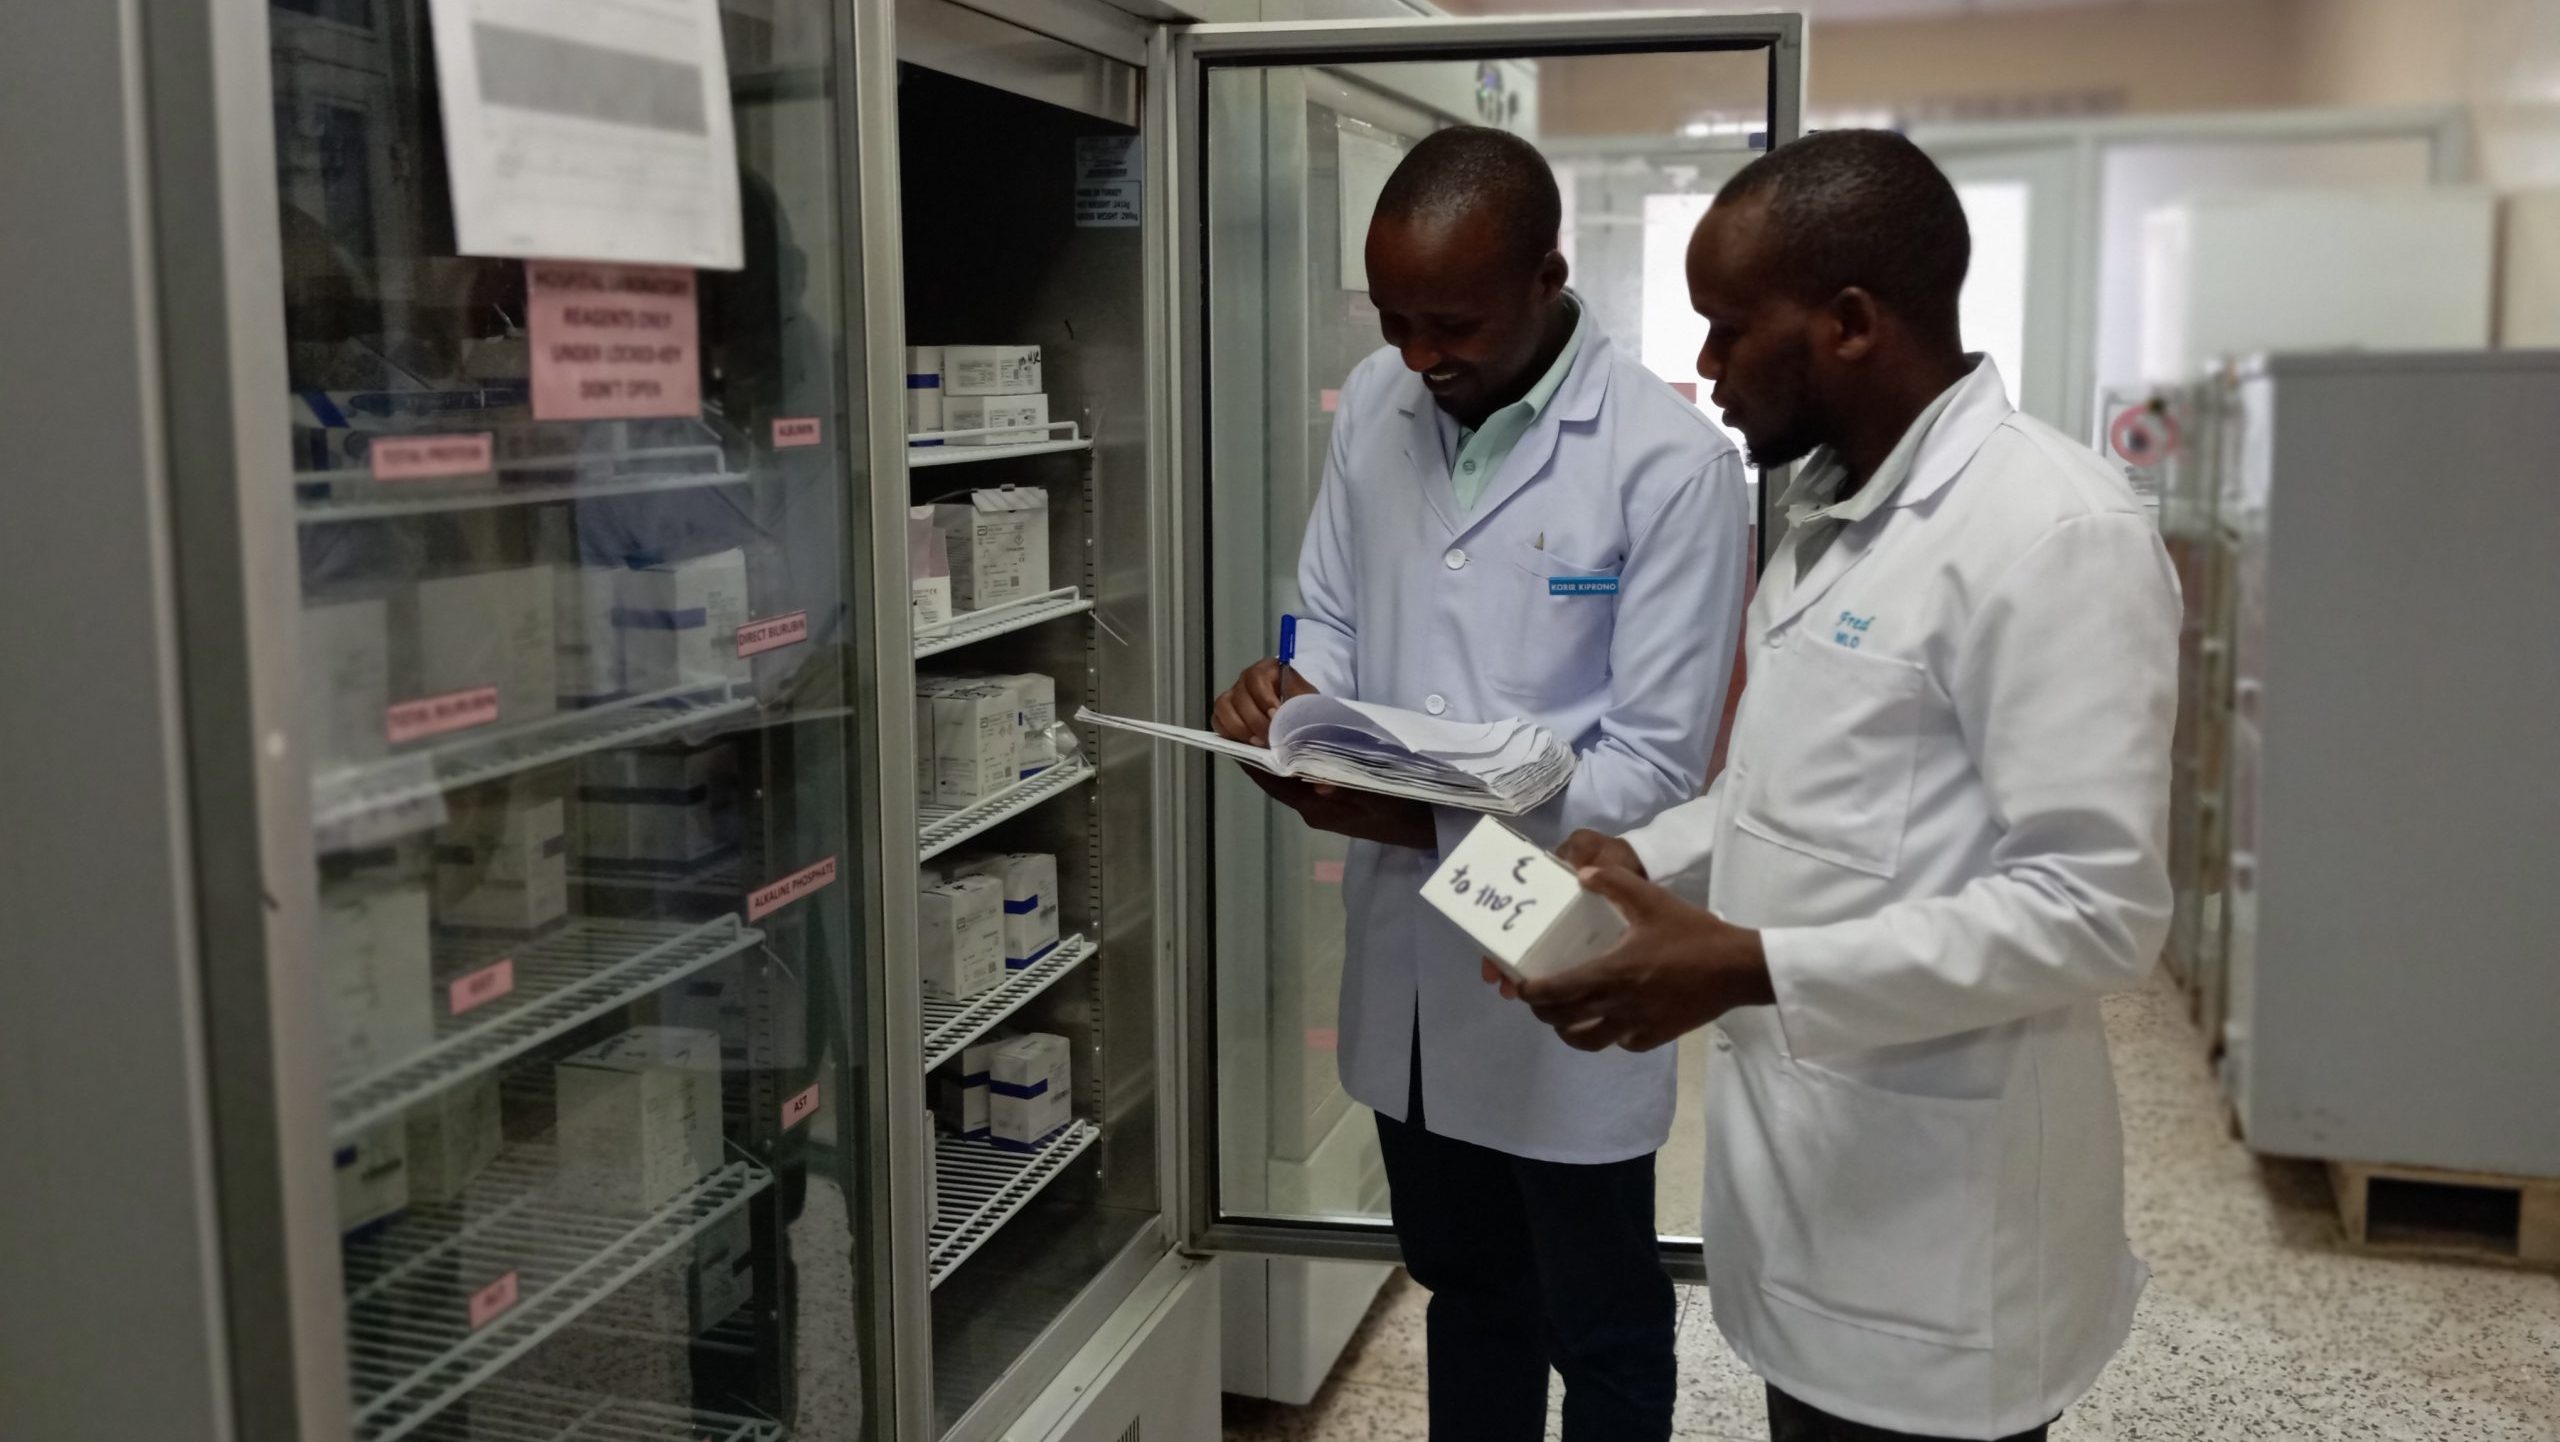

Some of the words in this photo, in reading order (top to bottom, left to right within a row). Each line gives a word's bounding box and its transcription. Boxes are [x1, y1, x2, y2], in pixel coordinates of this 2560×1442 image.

[563, 306, 635, 328] REAGENTS
[1551, 583, 1576, 591] KORIR
[1578, 583, 1617, 591] KIPRONO
[738, 628, 766, 647] DIRECT
[768, 619, 805, 639] BILIRUBIN
[755, 882, 791, 908] ALKALINE
[792, 862, 835, 889] PHOSPHATE
[794, 1094, 808, 1112] AST
